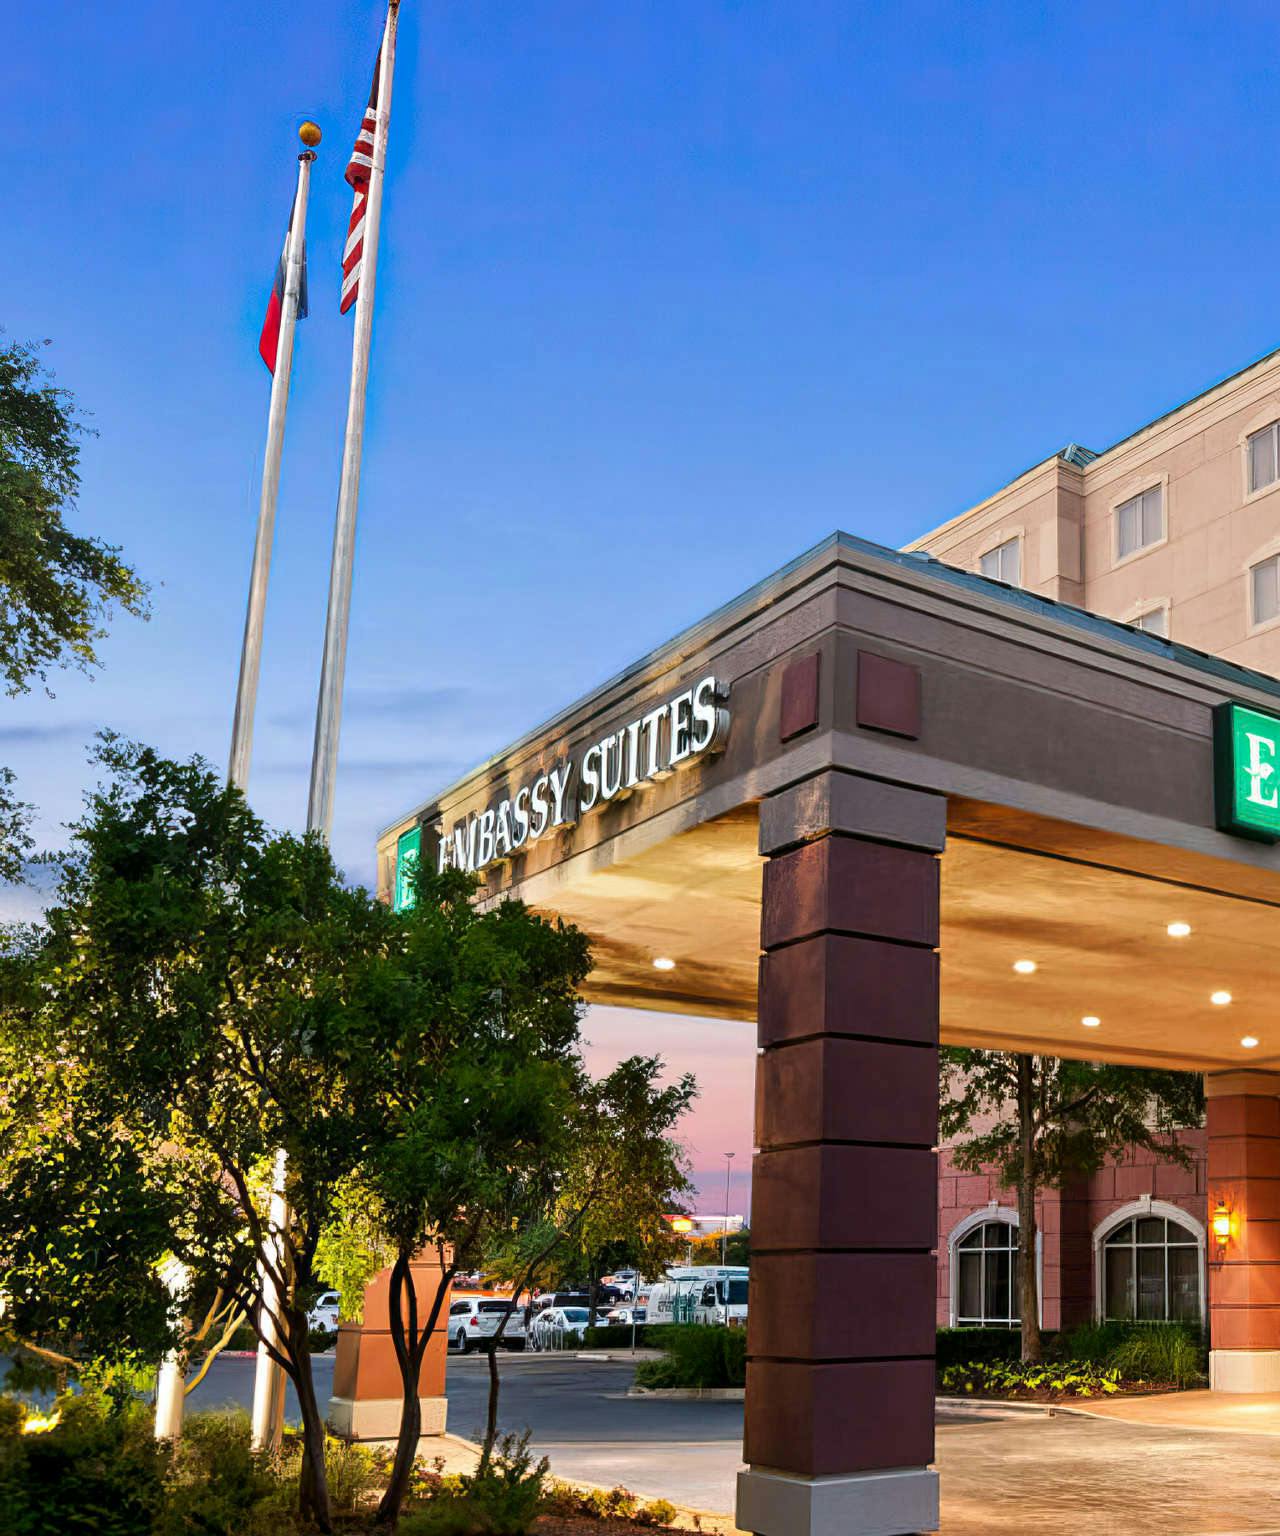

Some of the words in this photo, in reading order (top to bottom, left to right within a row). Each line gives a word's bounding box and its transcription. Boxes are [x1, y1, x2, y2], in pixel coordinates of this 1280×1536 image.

[438, 761, 573, 875] EMBASSY
[580, 675, 722, 814] SUITES
[1243, 732, 1278, 809] E
